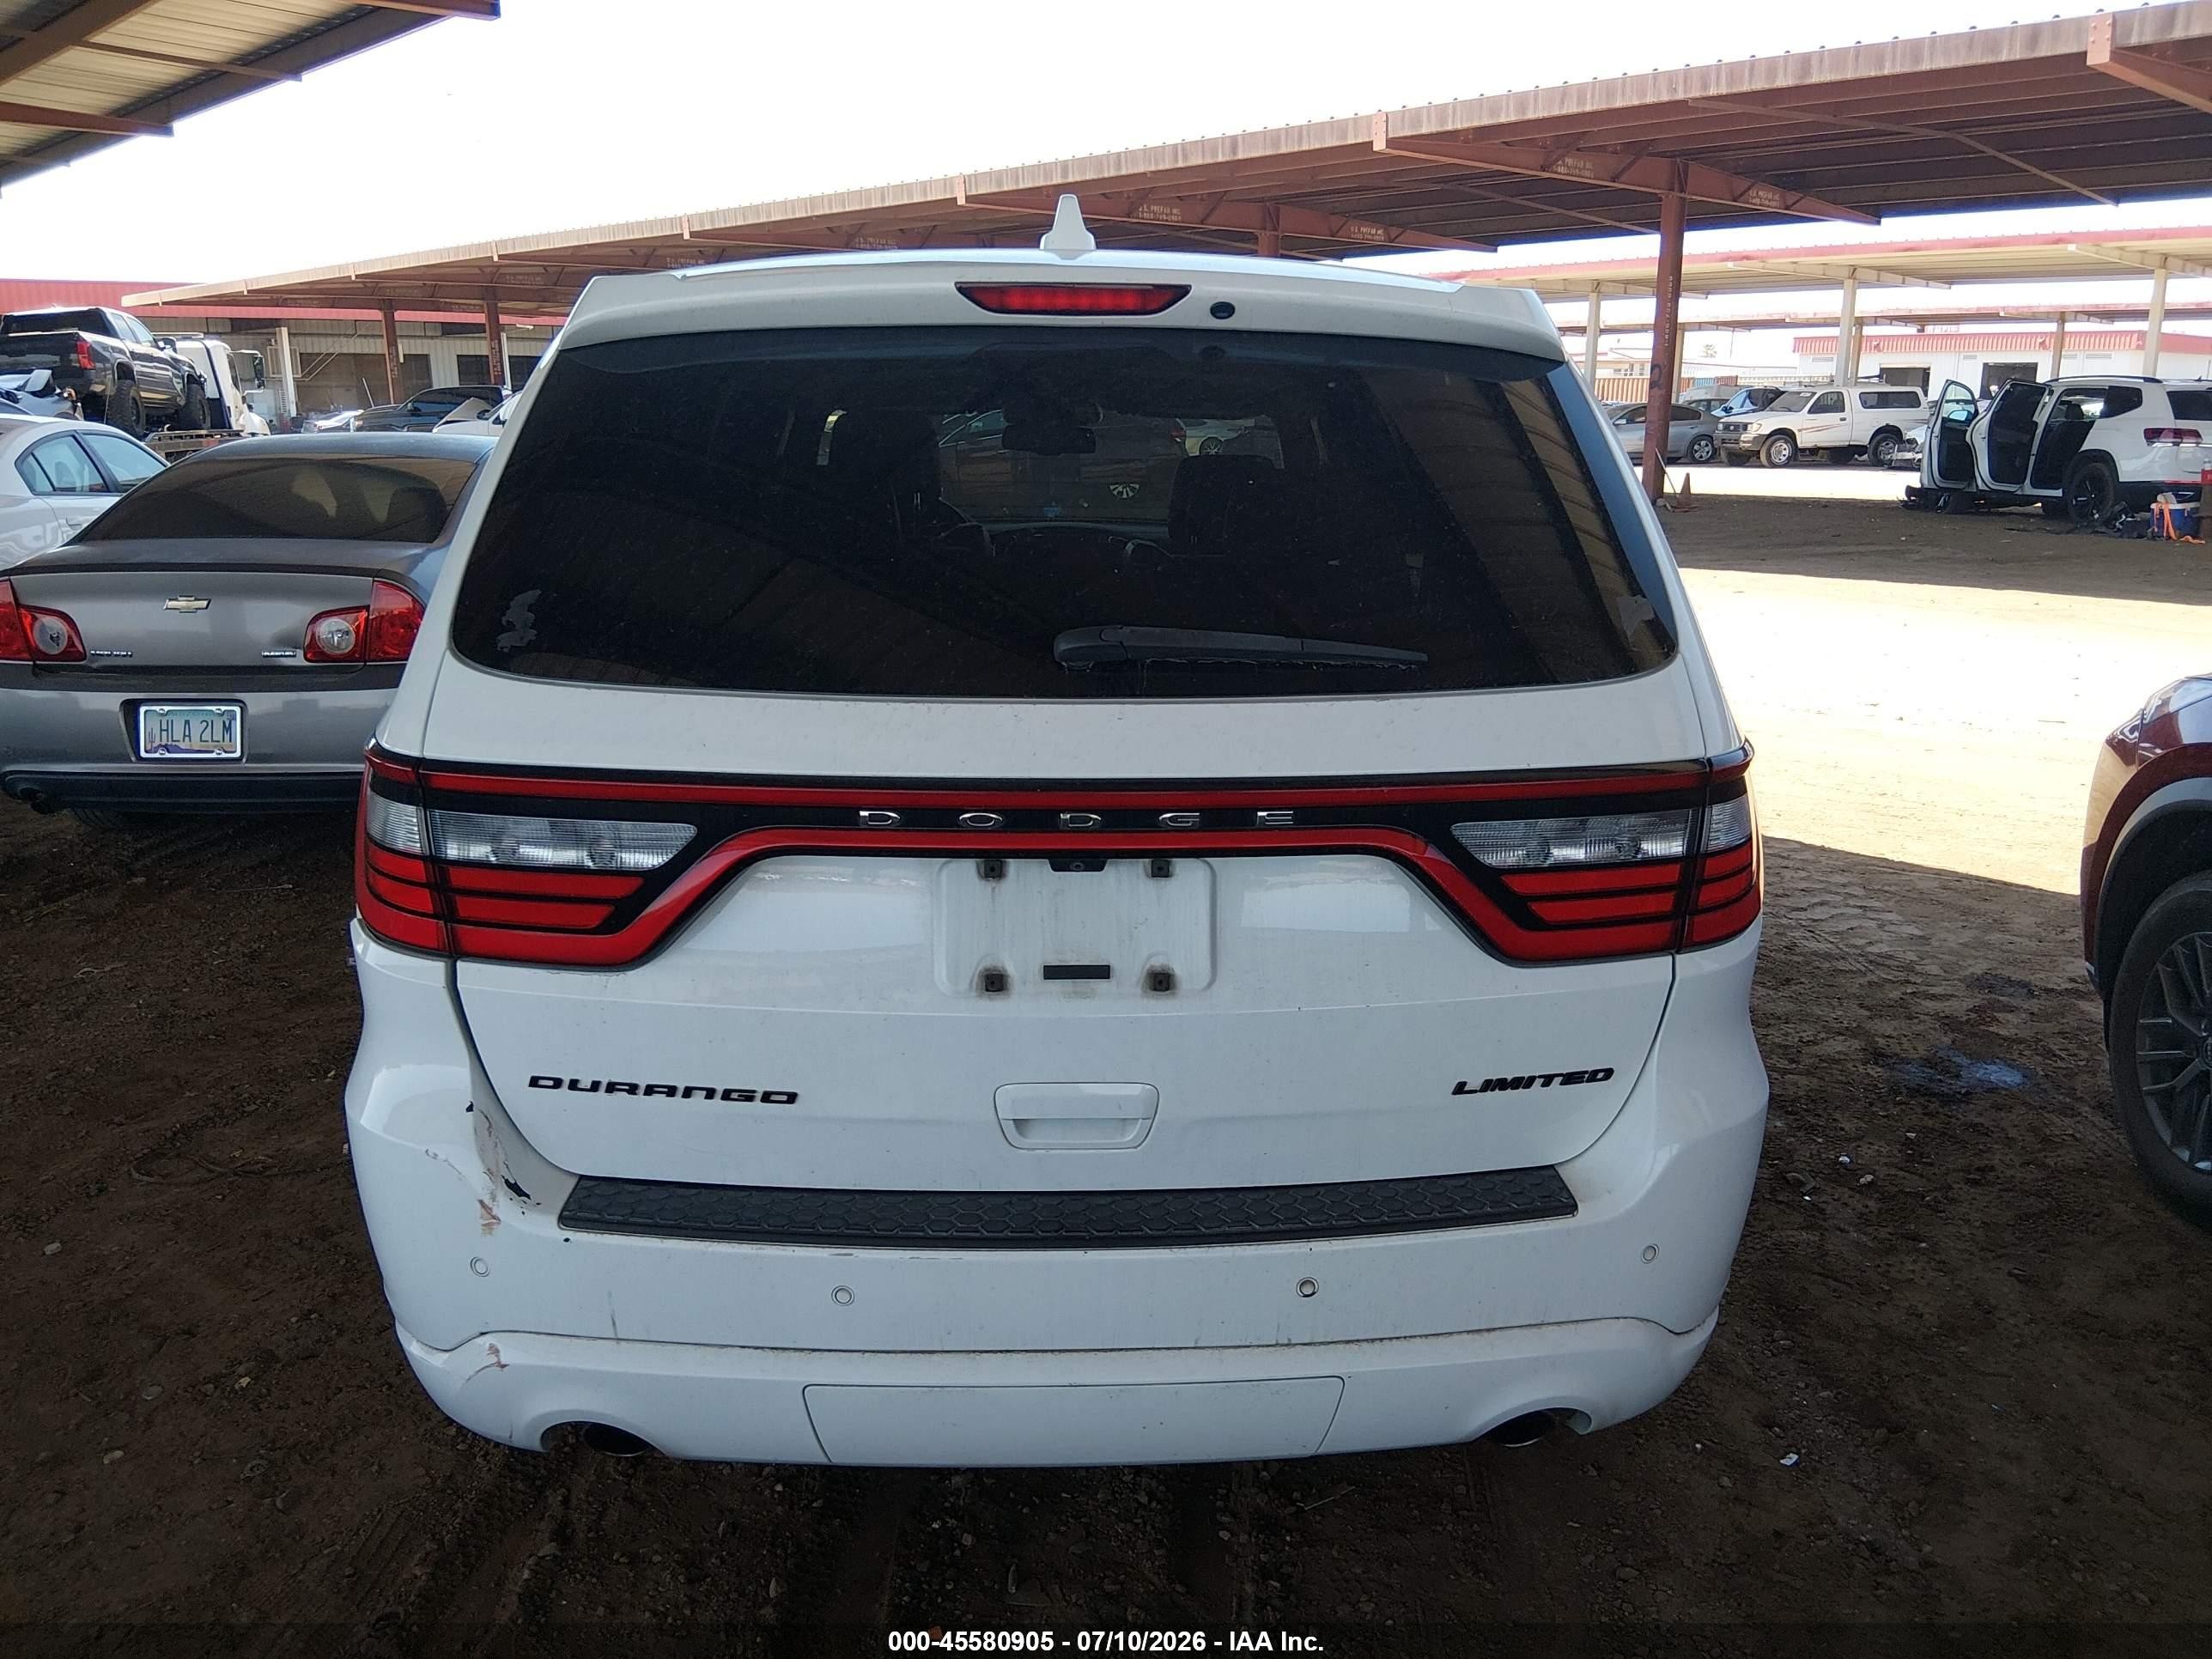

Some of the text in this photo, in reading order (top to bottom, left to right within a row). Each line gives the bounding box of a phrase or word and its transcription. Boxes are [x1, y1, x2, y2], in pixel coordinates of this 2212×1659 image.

[159, 719, 233, 743] HLA 2LM
[859, 810, 1294, 828] DODGE
[528, 1075, 799, 1105] DURANGO
[1451, 1066, 1614, 1097] LIMITED
